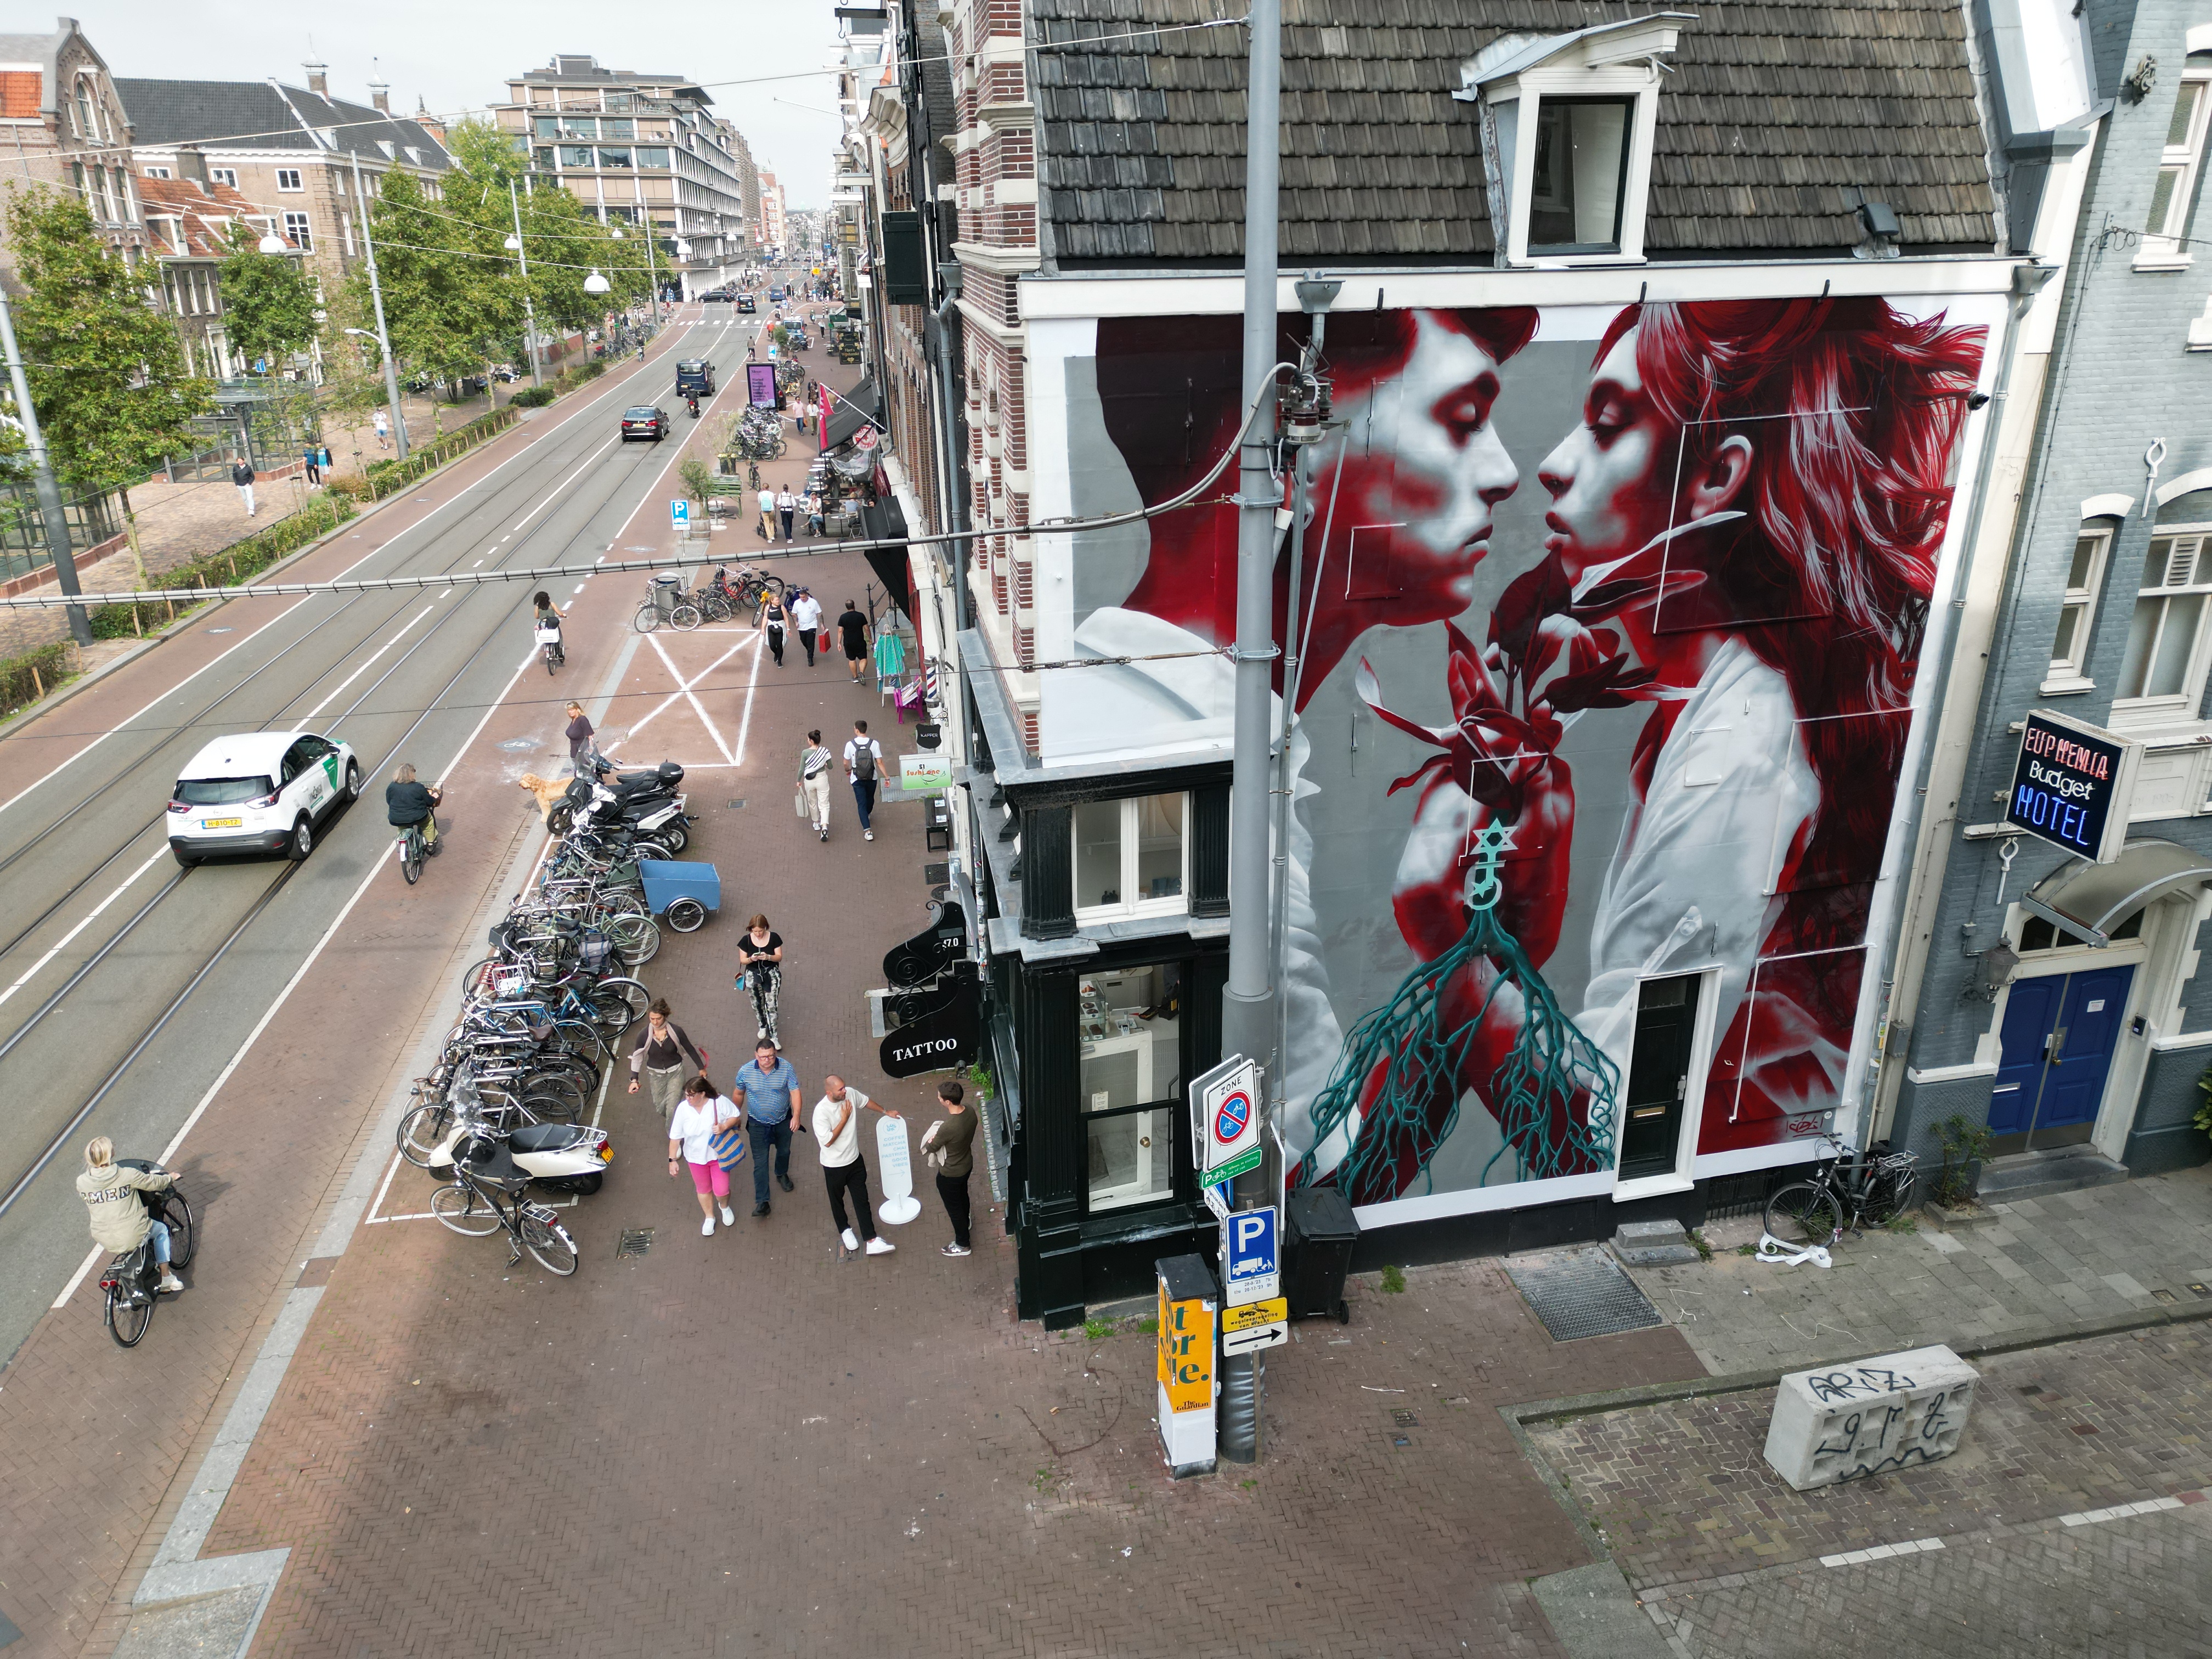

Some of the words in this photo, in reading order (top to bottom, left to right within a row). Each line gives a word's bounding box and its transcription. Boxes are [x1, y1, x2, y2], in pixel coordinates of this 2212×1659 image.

[674, 503, 685, 516] P
[2025, 727, 2108, 780] EUPHEMIA
[2029, 760, 2094, 800] Budget
[2015, 785, 2089, 845] HOTEL
[893, 1039, 957, 1061] TATTOO
[1221, 1076, 1242, 1096] ZONE
[1205, 1174, 1212, 1185] P
[1238, 1217, 1265, 1253] P
[1231, 1312, 1278, 1325] wegsleepregeling
[1176, 1402, 1209, 1411] Guardian
